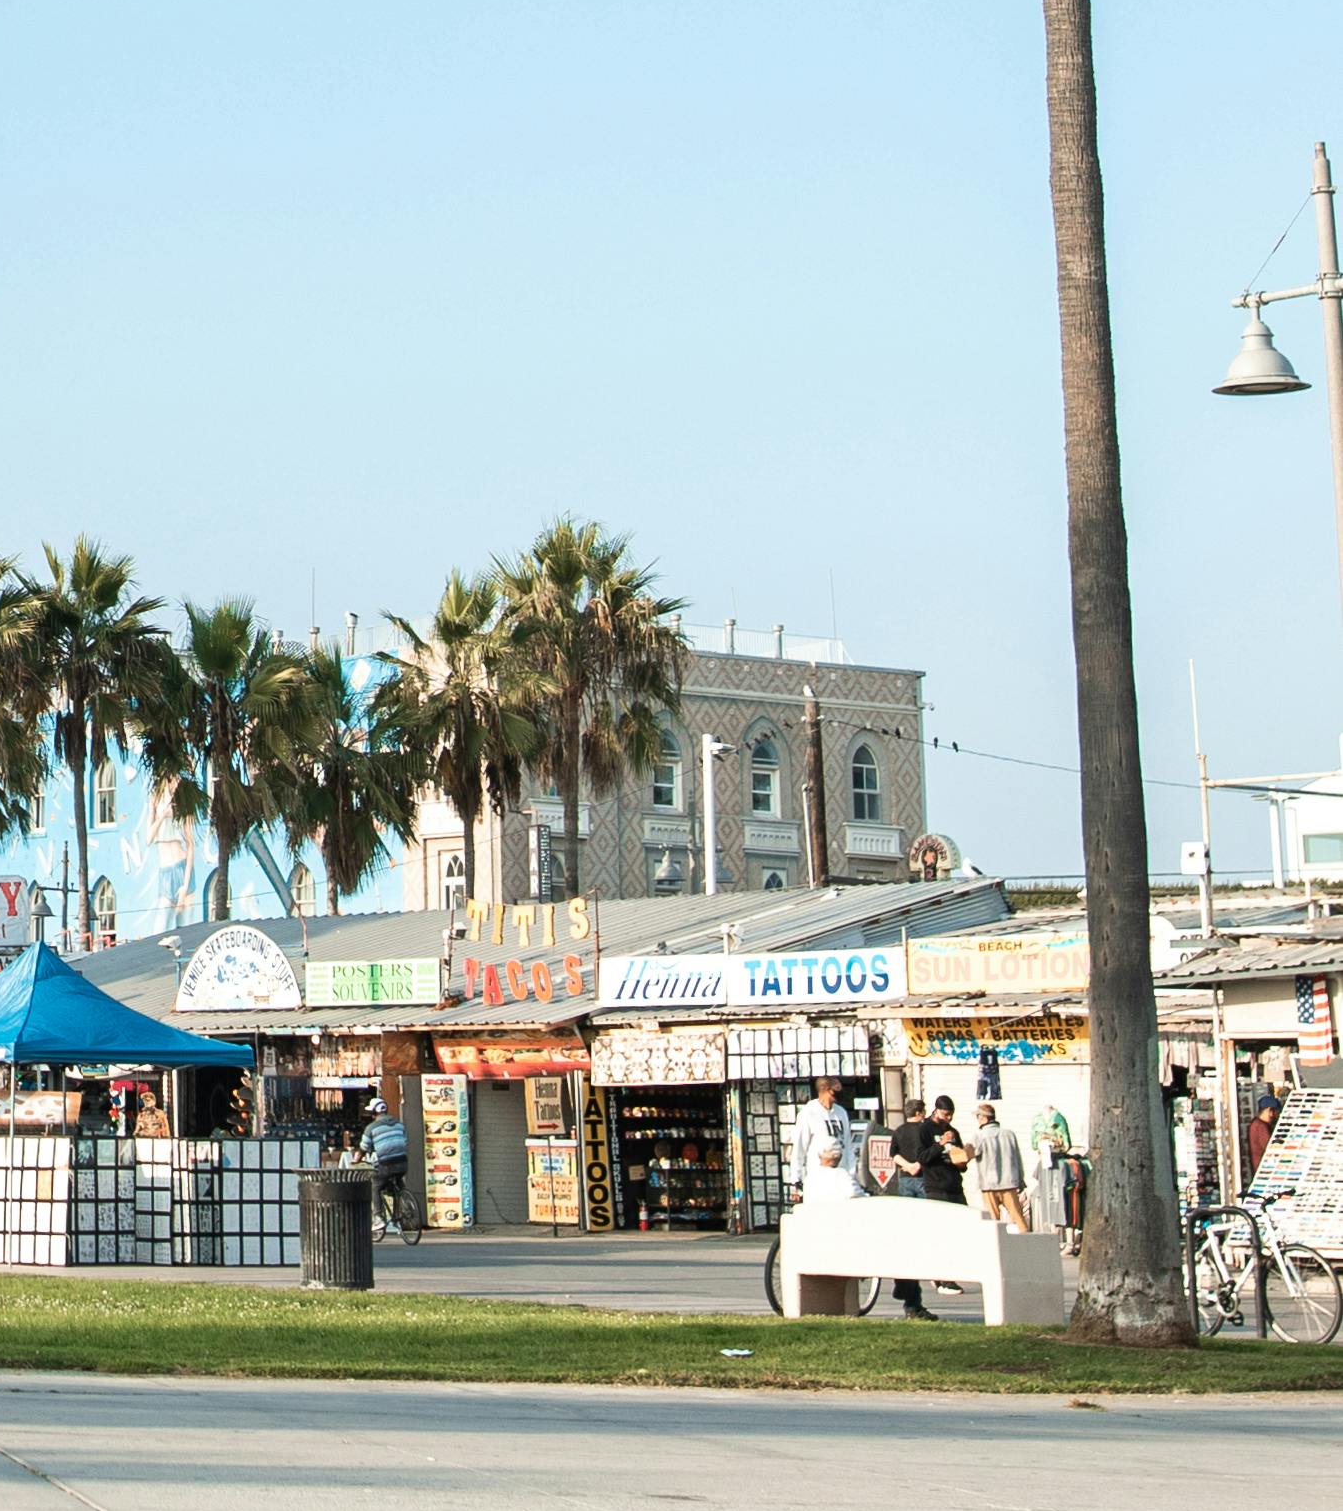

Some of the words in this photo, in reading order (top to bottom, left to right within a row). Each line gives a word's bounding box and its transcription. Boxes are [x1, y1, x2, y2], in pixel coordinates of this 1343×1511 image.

[978, 940, 1023, 952] BEACH
[182, 956, 207, 998] VENICE
[205, 930, 271, 961] SKATEBOARDING
[271, 953, 295, 992] STUFF
[331, 963, 413, 978] POSTERS
[914, 955, 972, 984] SUN
[984, 950, 1091, 980] LOTION
[463, 953, 585, 1006] TACOS
[614, 960, 722, 1000] Henna
[744, 953, 890, 997] TATTOOS
[331, 981, 413, 1002] SOUVENIRS
[911, 1016, 972, 1029] WATERS
[988, 1015, 1085, 1028] CIGARETTES
[991, 1028, 1077, 1041] BATTERIES
[535, 1077, 558, 1098] Henna
[534, 1100, 561, 1121] Tattoos
